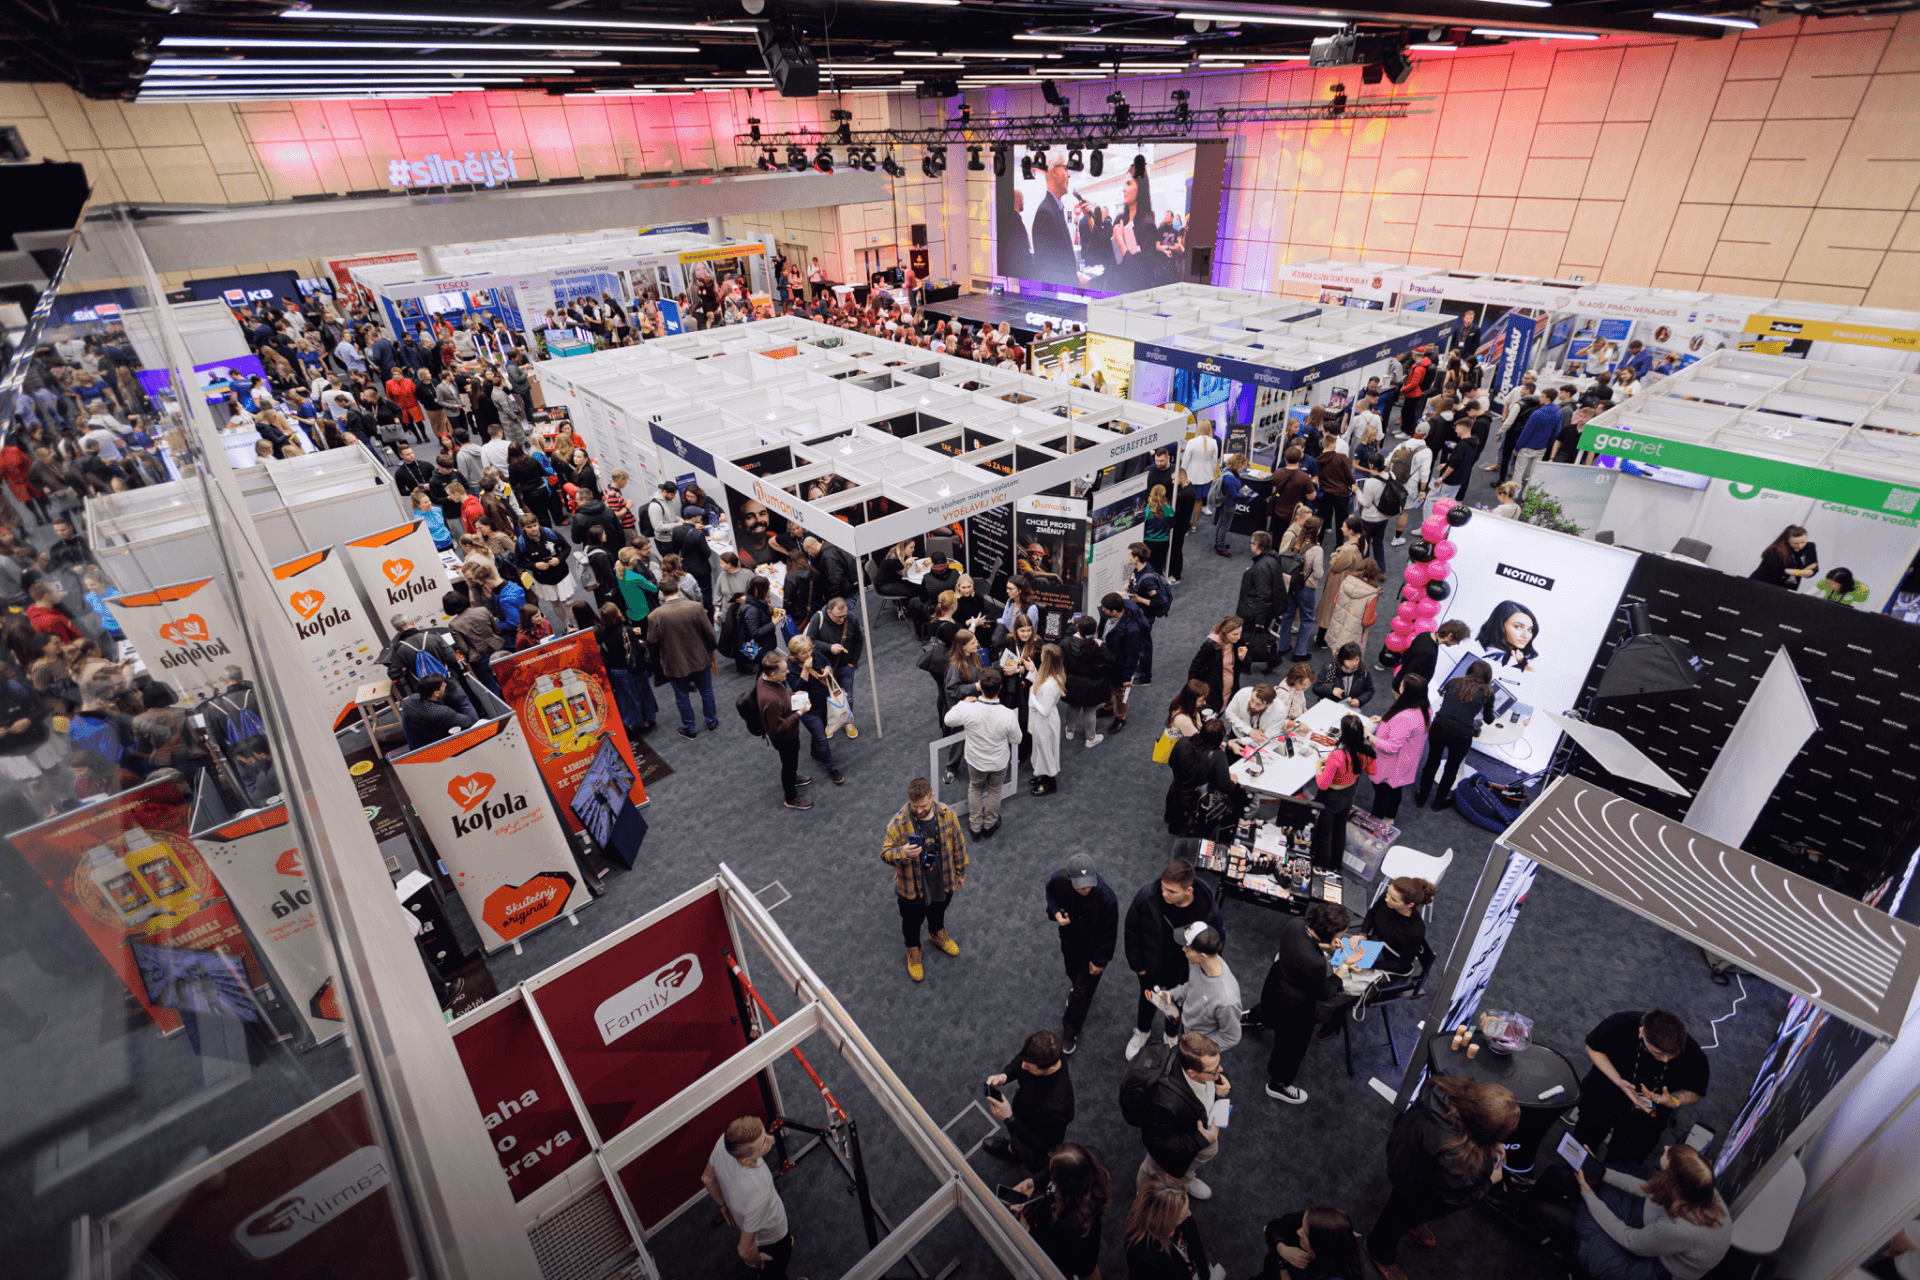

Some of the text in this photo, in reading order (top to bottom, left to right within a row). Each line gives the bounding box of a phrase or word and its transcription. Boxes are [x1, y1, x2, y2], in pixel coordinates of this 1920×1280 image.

[388, 150, 518, 188] #silnější
[555, 264, 609, 277] Smartwings Group
[435, 281, 469, 290] TESCO
[247, 289, 274, 301] KB
[1607, 303, 1631, 312] PRÁCI
[1633, 306, 1678, 317] NENAJDEŠ
[1438, 326, 1453, 338] STOCK
[1776, 323, 1802, 333] Parker
[1832, 330, 1891, 343] ENGINEERING
[1146, 351, 1168, 362] STOCK
[1376, 347, 1392, 359] STOCK
[1197, 361, 1221, 373] STOCK
[1253, 372, 1281, 385] STOCK
[1303, 371, 1321, 383] STOCK
[941, 442, 952, 452] TAK
[1110, 432, 1158, 458] SCHAEFFLER
[1593, 433, 1665, 457] gasnet
[992, 461, 1001, 471] ZA
[927, 505, 940, 515] Dej
[941, 496, 967, 510] sbohem
[968, 489, 990, 501] nízkým
[942, 493, 1007, 521] VYDĚLÁVEJ VÍC!
[1861, 511, 1879, 520] na
[1025, 518, 1077, 531] CHCEŠ PROSTĚ
[1035, 526, 1066, 536] ZMĚNU?
[1502, 566, 1547, 587] NOTINO
[386, 575, 438, 605] kofola
[1659, 589, 1680, 597] NOTINO
[1627, 594, 1647, 602] NOTINO
[1681, 610, 1703, 618] NOTINO
[1718, 606, 1741, 615] NOTINO
[1649, 614, 1669, 622] NOTINO
[295, 606, 352, 641] kofola
[1779, 624, 1803, 633] NOTINO
[1705, 632, 1727, 641] NOTINO
[1740, 628, 1764, 637] NOTINO
[1669, 635, 1690, 643] NOTINO
[1803, 647, 1828, 656] NOTINO
[1847, 644, 1873, 654] NOTINO
[1728, 653, 1750, 662] NOTINO
[1831, 671, 1856, 680] NOTINO
[1873, 668, 1899, 678] NOTINO
[1715, 678, 1737, 687] NOTINO
[1816, 697, 1840, 706] NOTINO
[1856, 695, 1881, 705] NOTINO
[1900, 691, 1920, 702] NOTIN
[1607, 706, 1626, 714] NOTINO
[1637, 704, 1656, 713] NOTINO
[1670, 703, 1691, 712] NOTINO
[1702, 701, 1724, 711] NOTINO
[1691, 724, 1711, 733] NOTINO
[1840, 720, 1864, 730] NOTINO
[1882, 718, 1908, 729] NOTINO
[1627, 726, 1646, 734] NOTINO
[1659, 725, 1679, 734] NOTINO
[1649, 747, 1668, 755] NOTINO
[1679, 746, 1700, 755] NOTINO
[1825, 744, 1848, 755] NOTINO
[1866, 744, 1890, 754] NOTINO
[562, 752, 596, 775] LIMONÁ
[557, 770, 587, 789] ZE SIC
[451, 792, 529, 839] kofola
[505, 885, 557, 915] Skutečný
[502, 898, 549, 928] originál
[604, 989, 669, 1036] Family
[484, 1089, 540, 1130] aha
[498, 1135, 517, 1152] o
[504, 1130, 572, 1181] trava
